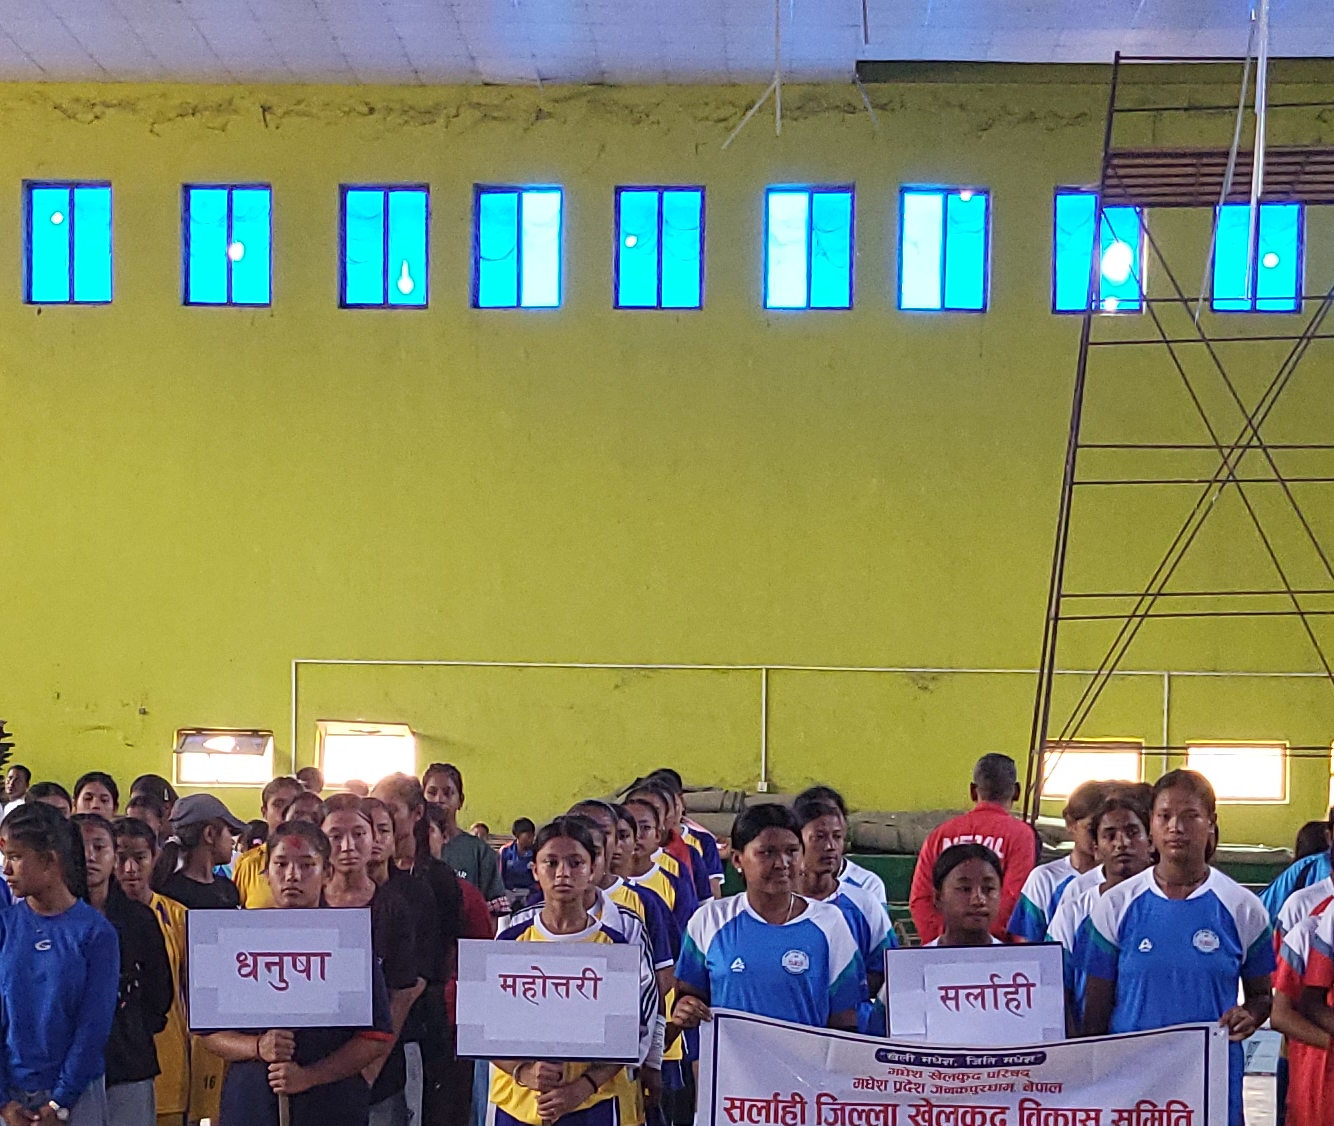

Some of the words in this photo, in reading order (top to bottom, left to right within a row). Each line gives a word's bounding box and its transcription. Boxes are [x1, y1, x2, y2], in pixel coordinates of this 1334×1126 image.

[235, 950, 332, 992] धनुषा
[499, 965, 603, 1006] महोत्तरी
[938, 972, 1037, 1018] सर्लाही
[852, 1075, 889, 1092] मधेश
[893, 1079, 926, 1095] प्रदेश
[1022, 1078, 1064, 1094] नेपाल
[888, 1067, 923, 1079] मधेश
[927, 1069, 982, 1083] खेलकुद
